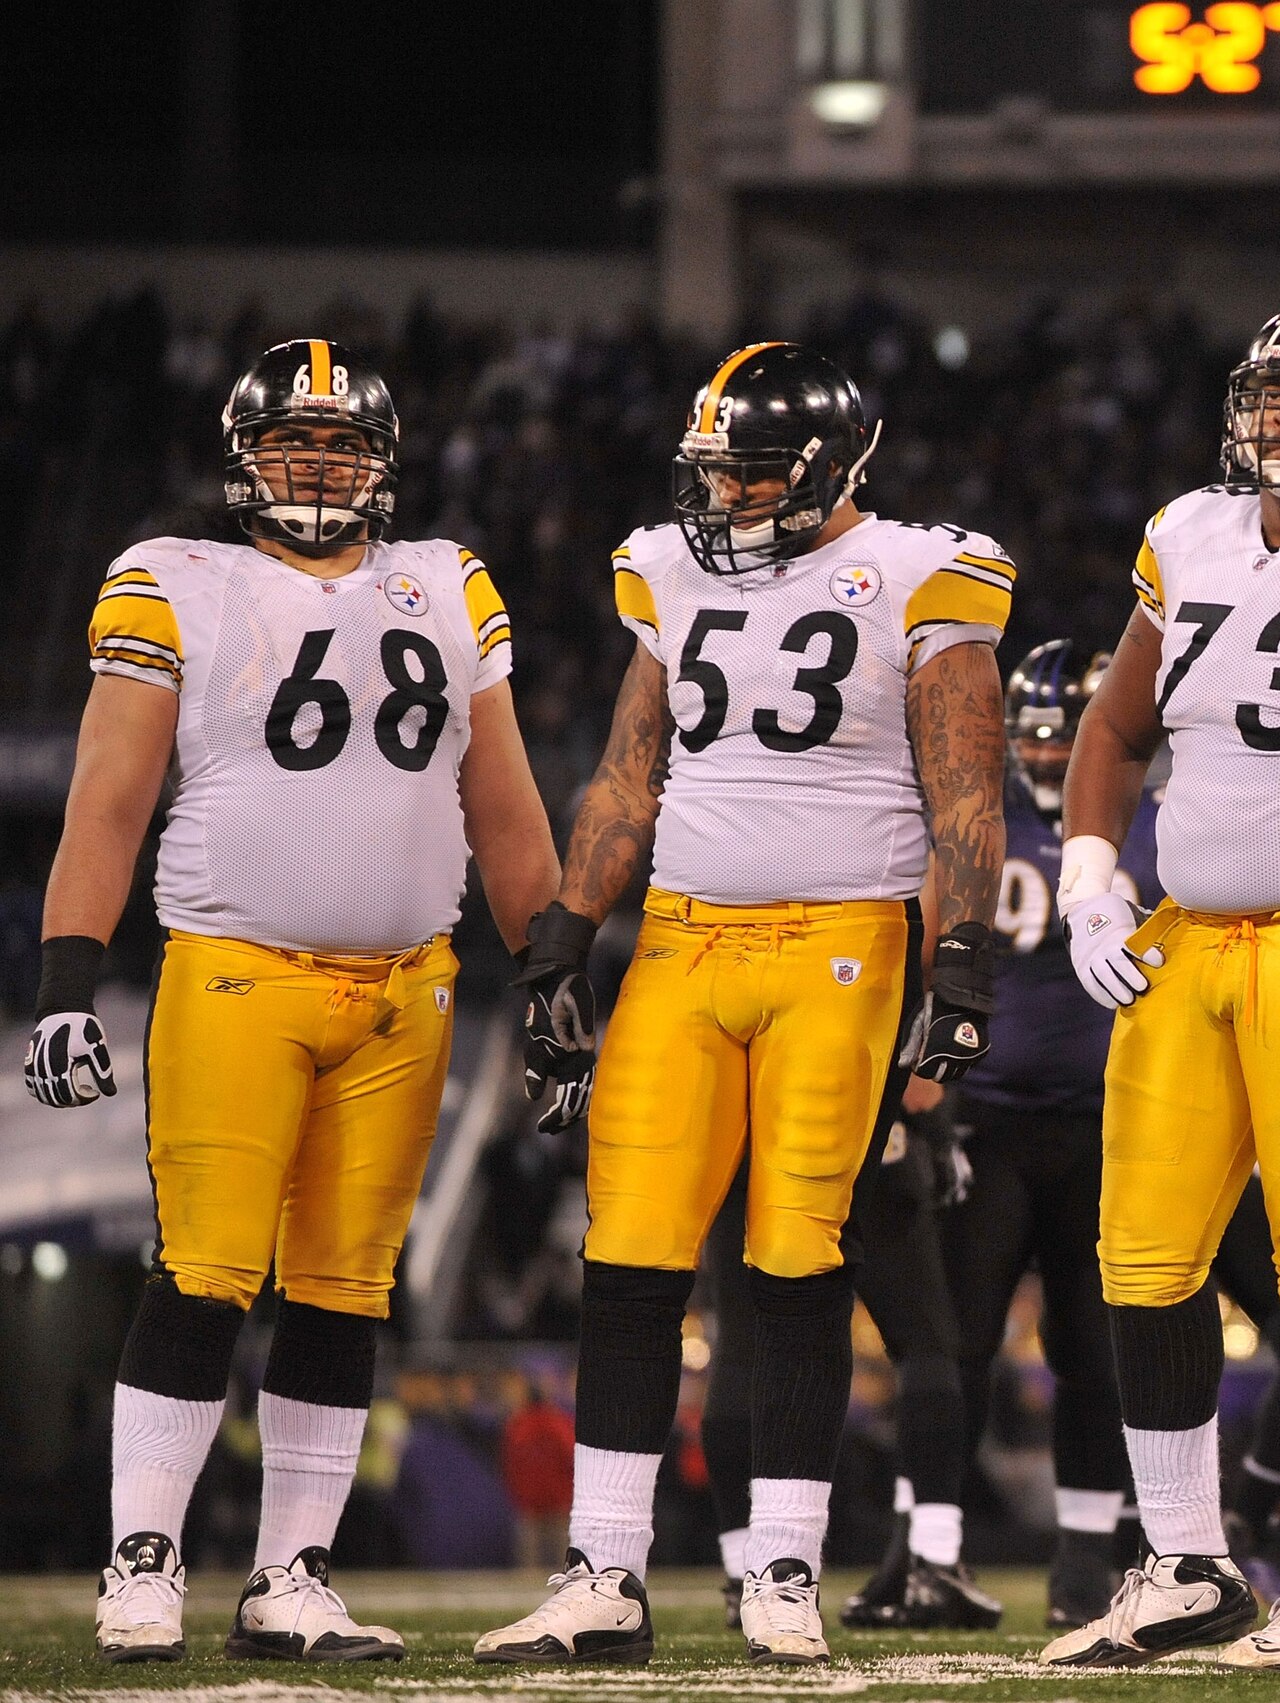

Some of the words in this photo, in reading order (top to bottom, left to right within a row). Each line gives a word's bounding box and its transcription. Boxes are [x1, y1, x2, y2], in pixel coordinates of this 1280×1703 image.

[292, 364, 348, 396] 68
[265, 628, 451, 773] 68
[674, 609, 859, 753] 53
